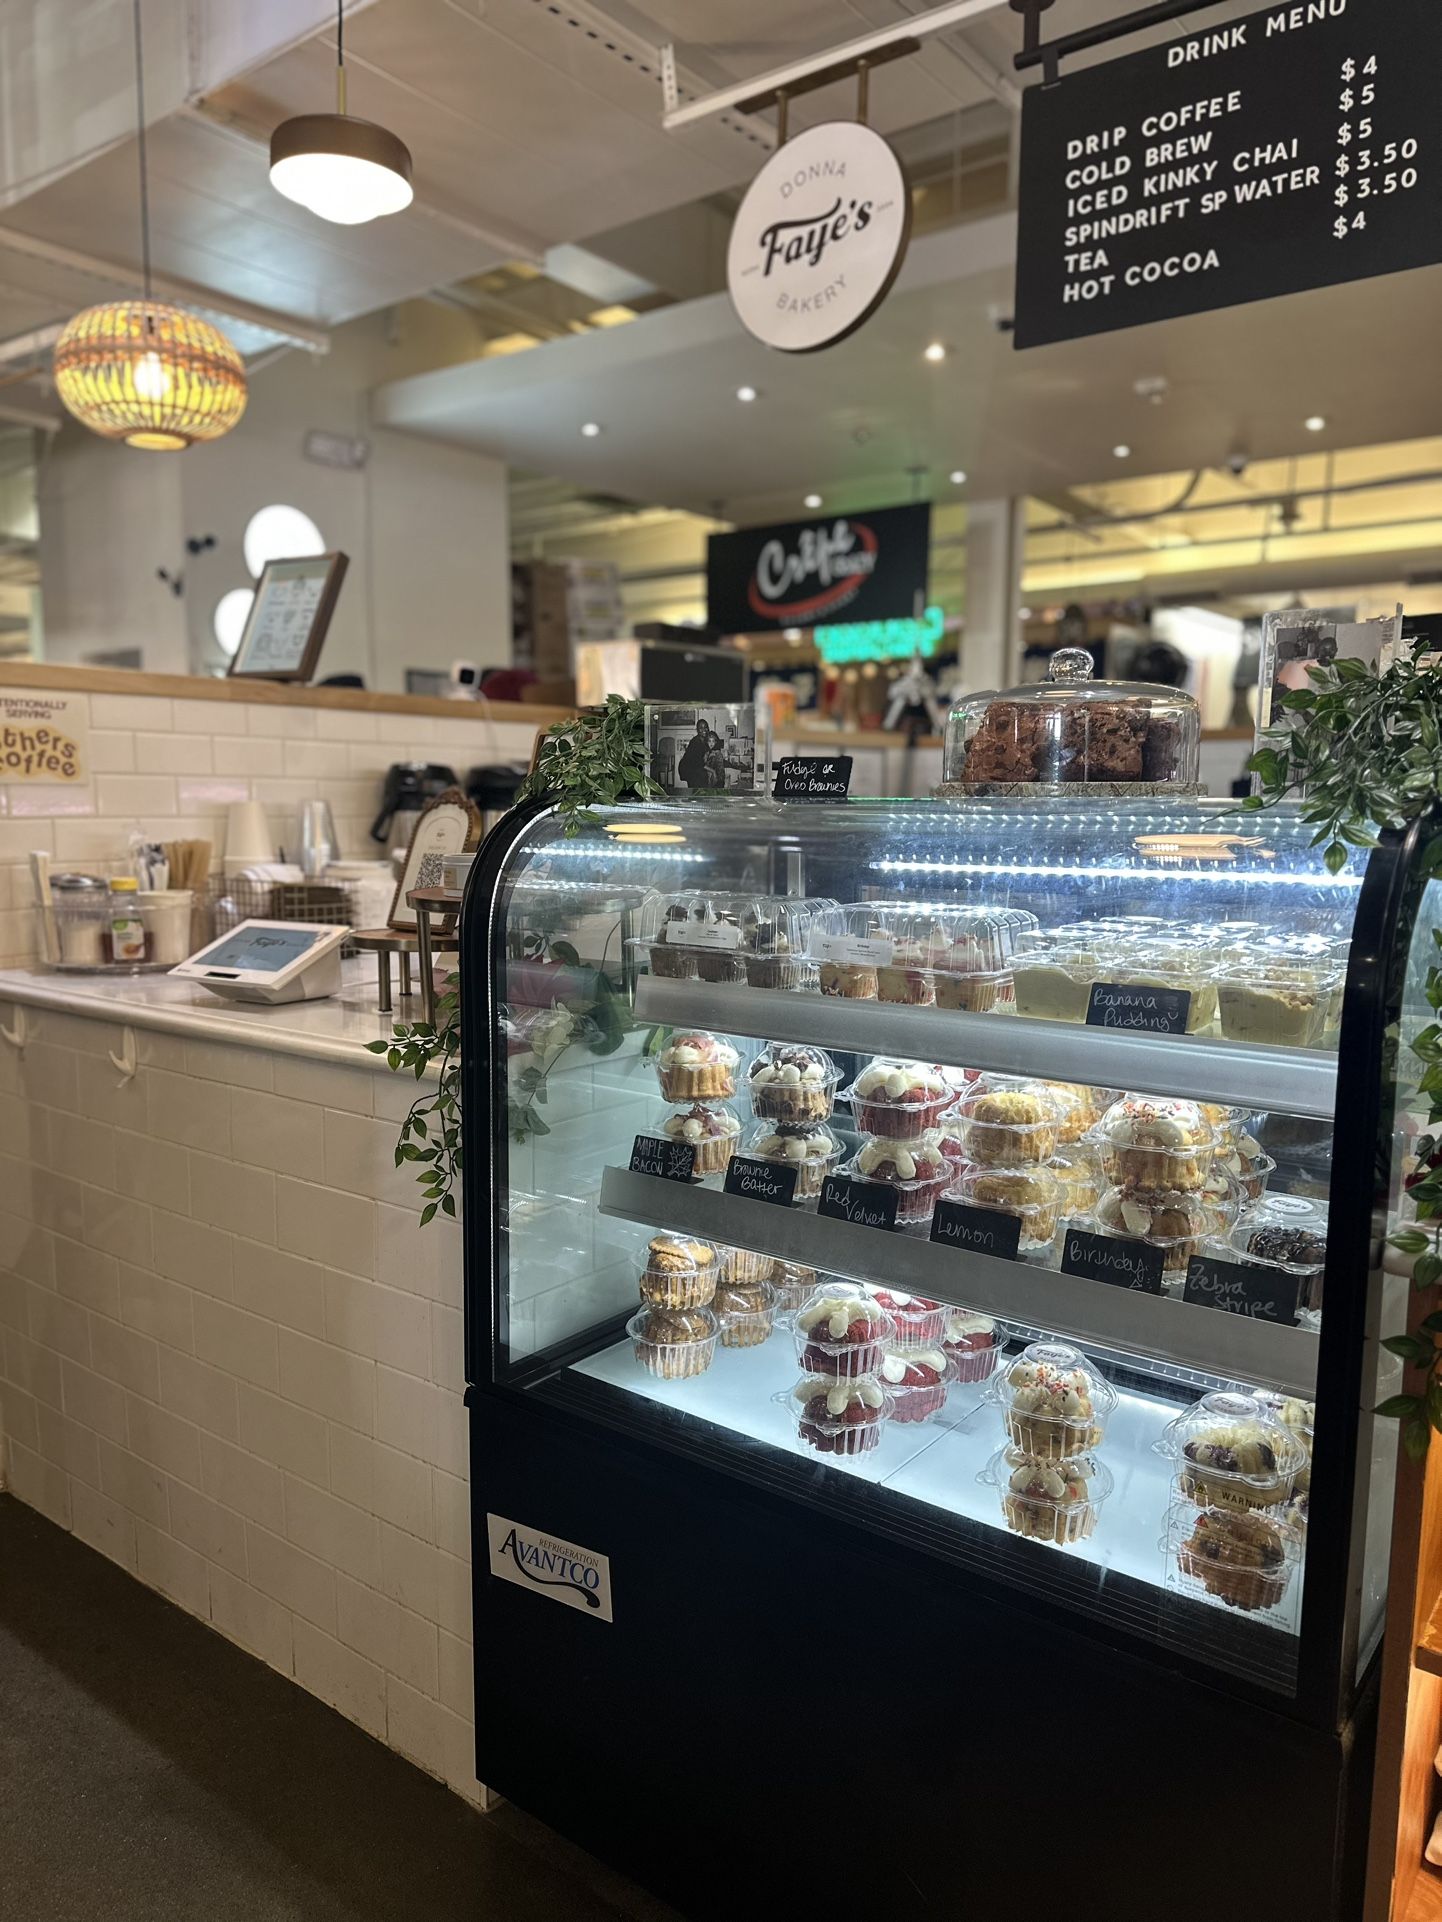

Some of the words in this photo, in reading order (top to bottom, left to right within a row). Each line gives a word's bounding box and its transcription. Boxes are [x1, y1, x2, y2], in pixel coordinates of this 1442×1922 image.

[1167, 25, 1247, 68] DRINK
[1265, 0, 1348, 38] MENU
[1066, 125, 1127, 160] DRIP
[1141, 91, 1242, 137] COFFEE
[1065, 156, 1132, 190] COLD
[1144, 130, 1213, 168] BREW
[779, 159, 847, 199] DONNA
[1067, 184, 1129, 218] ICED
[1143, 160, 1219, 198] KINKY
[1232, 138, 1299, 173] CHAI
[1064, 198, 1190, 248] SPINDRIFT
[1200, 190, 1228, 215] SP
[1234, 165, 1321, 204] WATER
[759, 197, 873, 277] Faye's
[1063, 274, 1115, 303] HOT
[1124, 249, 1220, 287] COCOA
[1064, 248, 1109, 274] TEA
[776, 274, 848, 314] BAKERY
[6, 708, 52, 719] SERVING
[0, 728, 76, 759] thers
[782, 761, 817, 779] Fudge
[784, 778, 807, 791] Oreo
[1093, 988, 1158, 1010] Banana
[1103, 1007, 1170, 1032] Pudding
[636, 1137, 665, 1159] MAPLE
[631, 1156, 664, 1176] BACON
[733, 1158, 773, 1180] Brownie
[741, 1176, 783, 1195] Batter
[825, 1183, 850, 1207] Red
[846, 1200, 887, 1225] Velvet
[937, 1213, 994, 1248] Lemon
[1189, 1263, 1248, 1297] Zebra
[1222, 1490, 1271, 1515] WARNING
[498, 1528, 601, 1608] AVANTCO
[539, 1538, 599, 1568] REFRIGERATION
